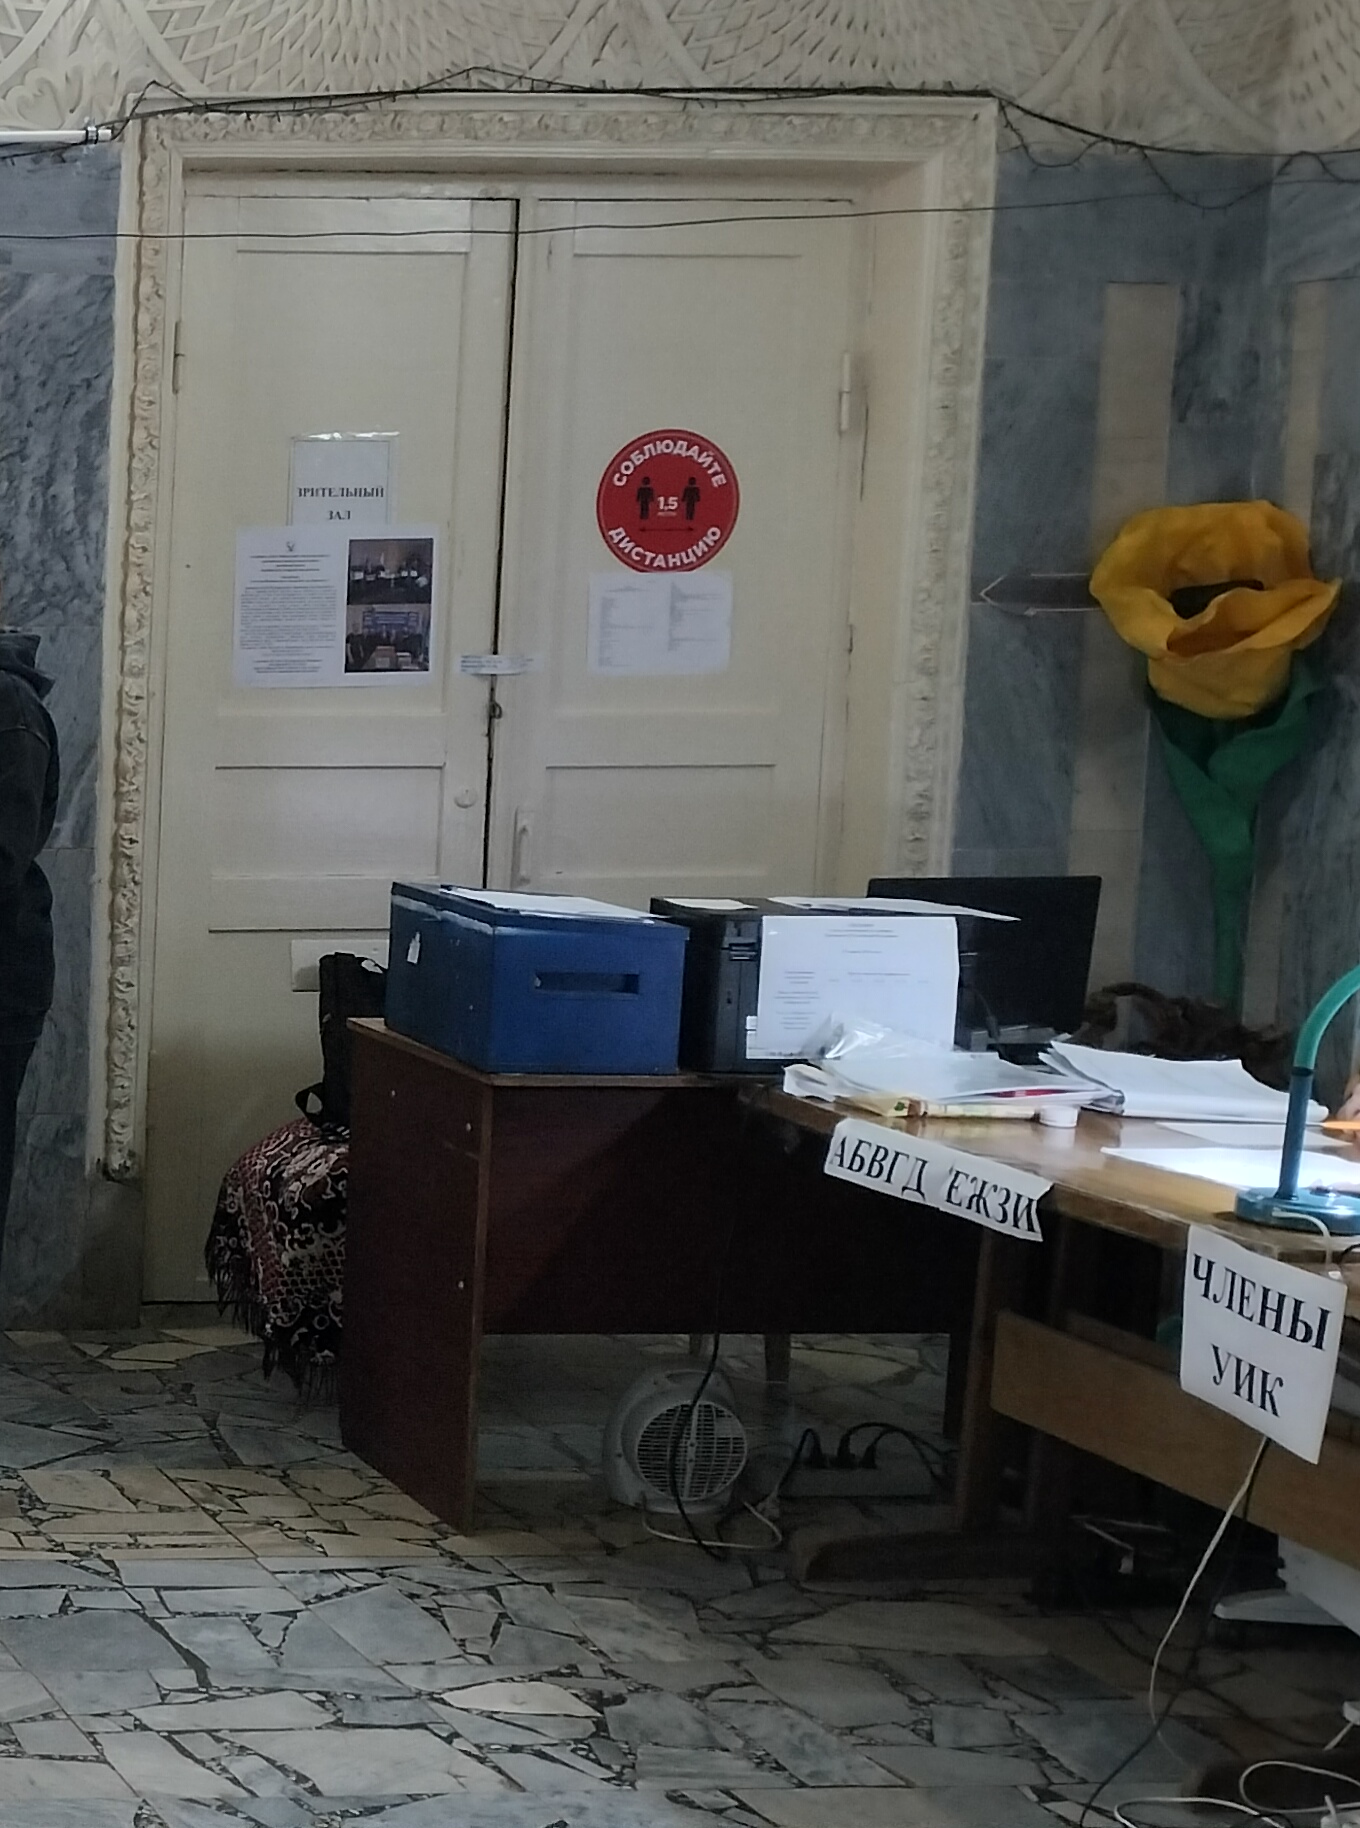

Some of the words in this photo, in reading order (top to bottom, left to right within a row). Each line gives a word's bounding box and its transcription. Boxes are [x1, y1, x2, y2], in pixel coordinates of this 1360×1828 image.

[613, 439, 727, 488] СОБЛЮДАЙТЕ
[298, 485, 384, 498] ЗРИТЕЛЬНЫЙ
[657, 496, 679, 511] 1,5
[328, 510, 351, 520] ЗАЛ
[608, 527, 721, 568] ДИСТАНЦИЮ
[830, 1136, 929, 1202] АБВГД
[945, 1166, 1038, 1233] ЕЖЗИ
[1193, 1253, 1332, 1351] ЧЛЕНЫ
[1211, 1343, 1284, 1418] УИК
